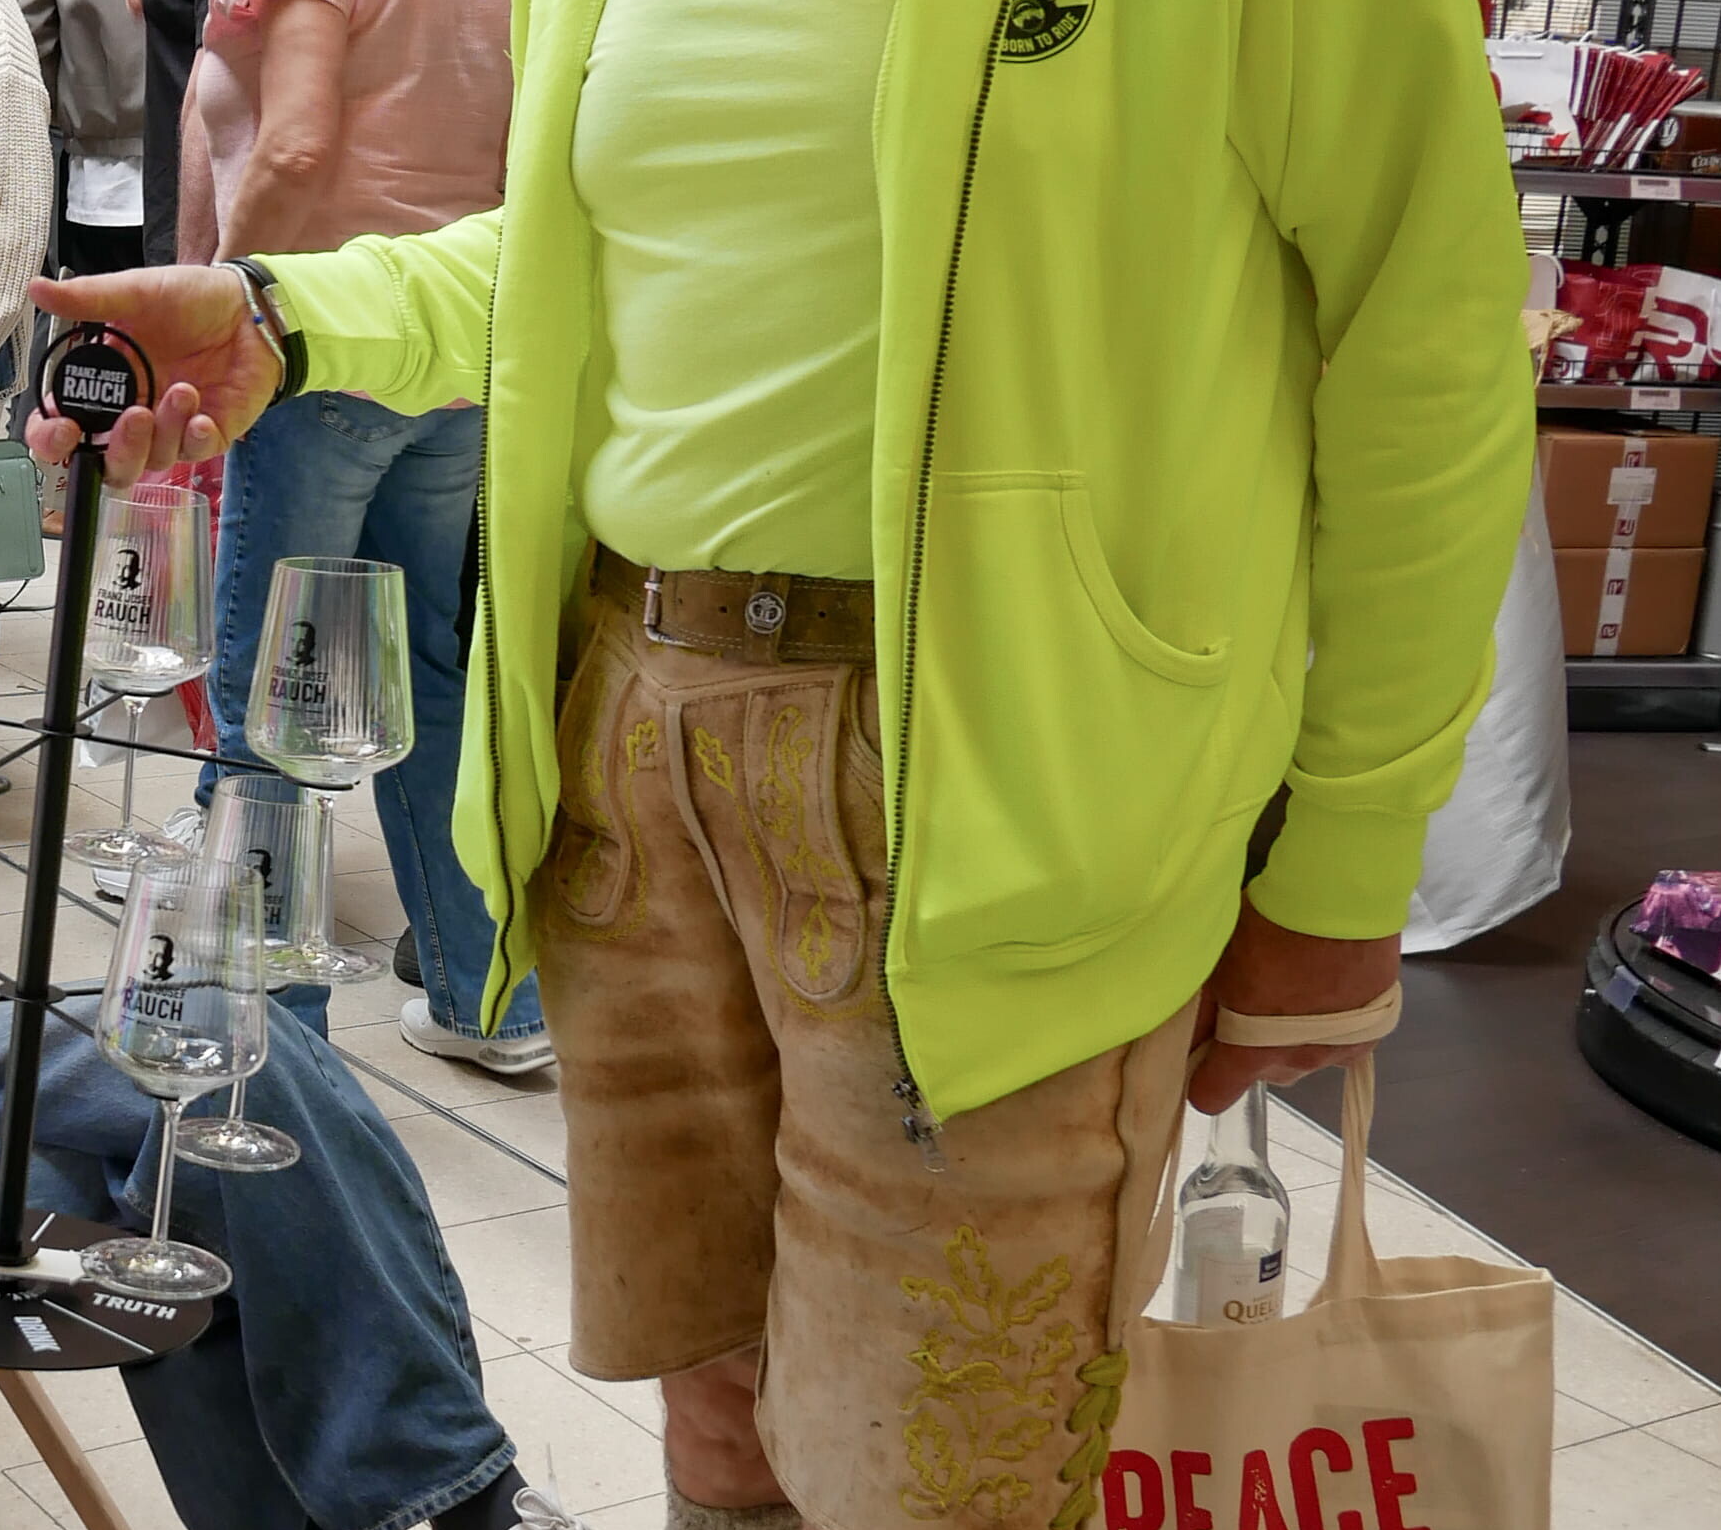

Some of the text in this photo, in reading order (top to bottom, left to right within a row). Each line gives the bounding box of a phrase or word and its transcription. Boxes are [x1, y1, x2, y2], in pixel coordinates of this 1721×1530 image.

[1001, 12, 1080, 53] BORN TO RIDE
[65, 364, 130, 384] FRANZ JOSEF
[62, 377, 126, 406] RAUCH
[96, 589, 123, 602] FRANZ
[94, 601, 151, 625] RAUCH
[268, 677, 327, 705] RAUCH
[123, 989, 184, 1022] RAUCH
[92, 1292, 179, 1321] TRUTH
[13, 1315, 62, 1353] DRINK
